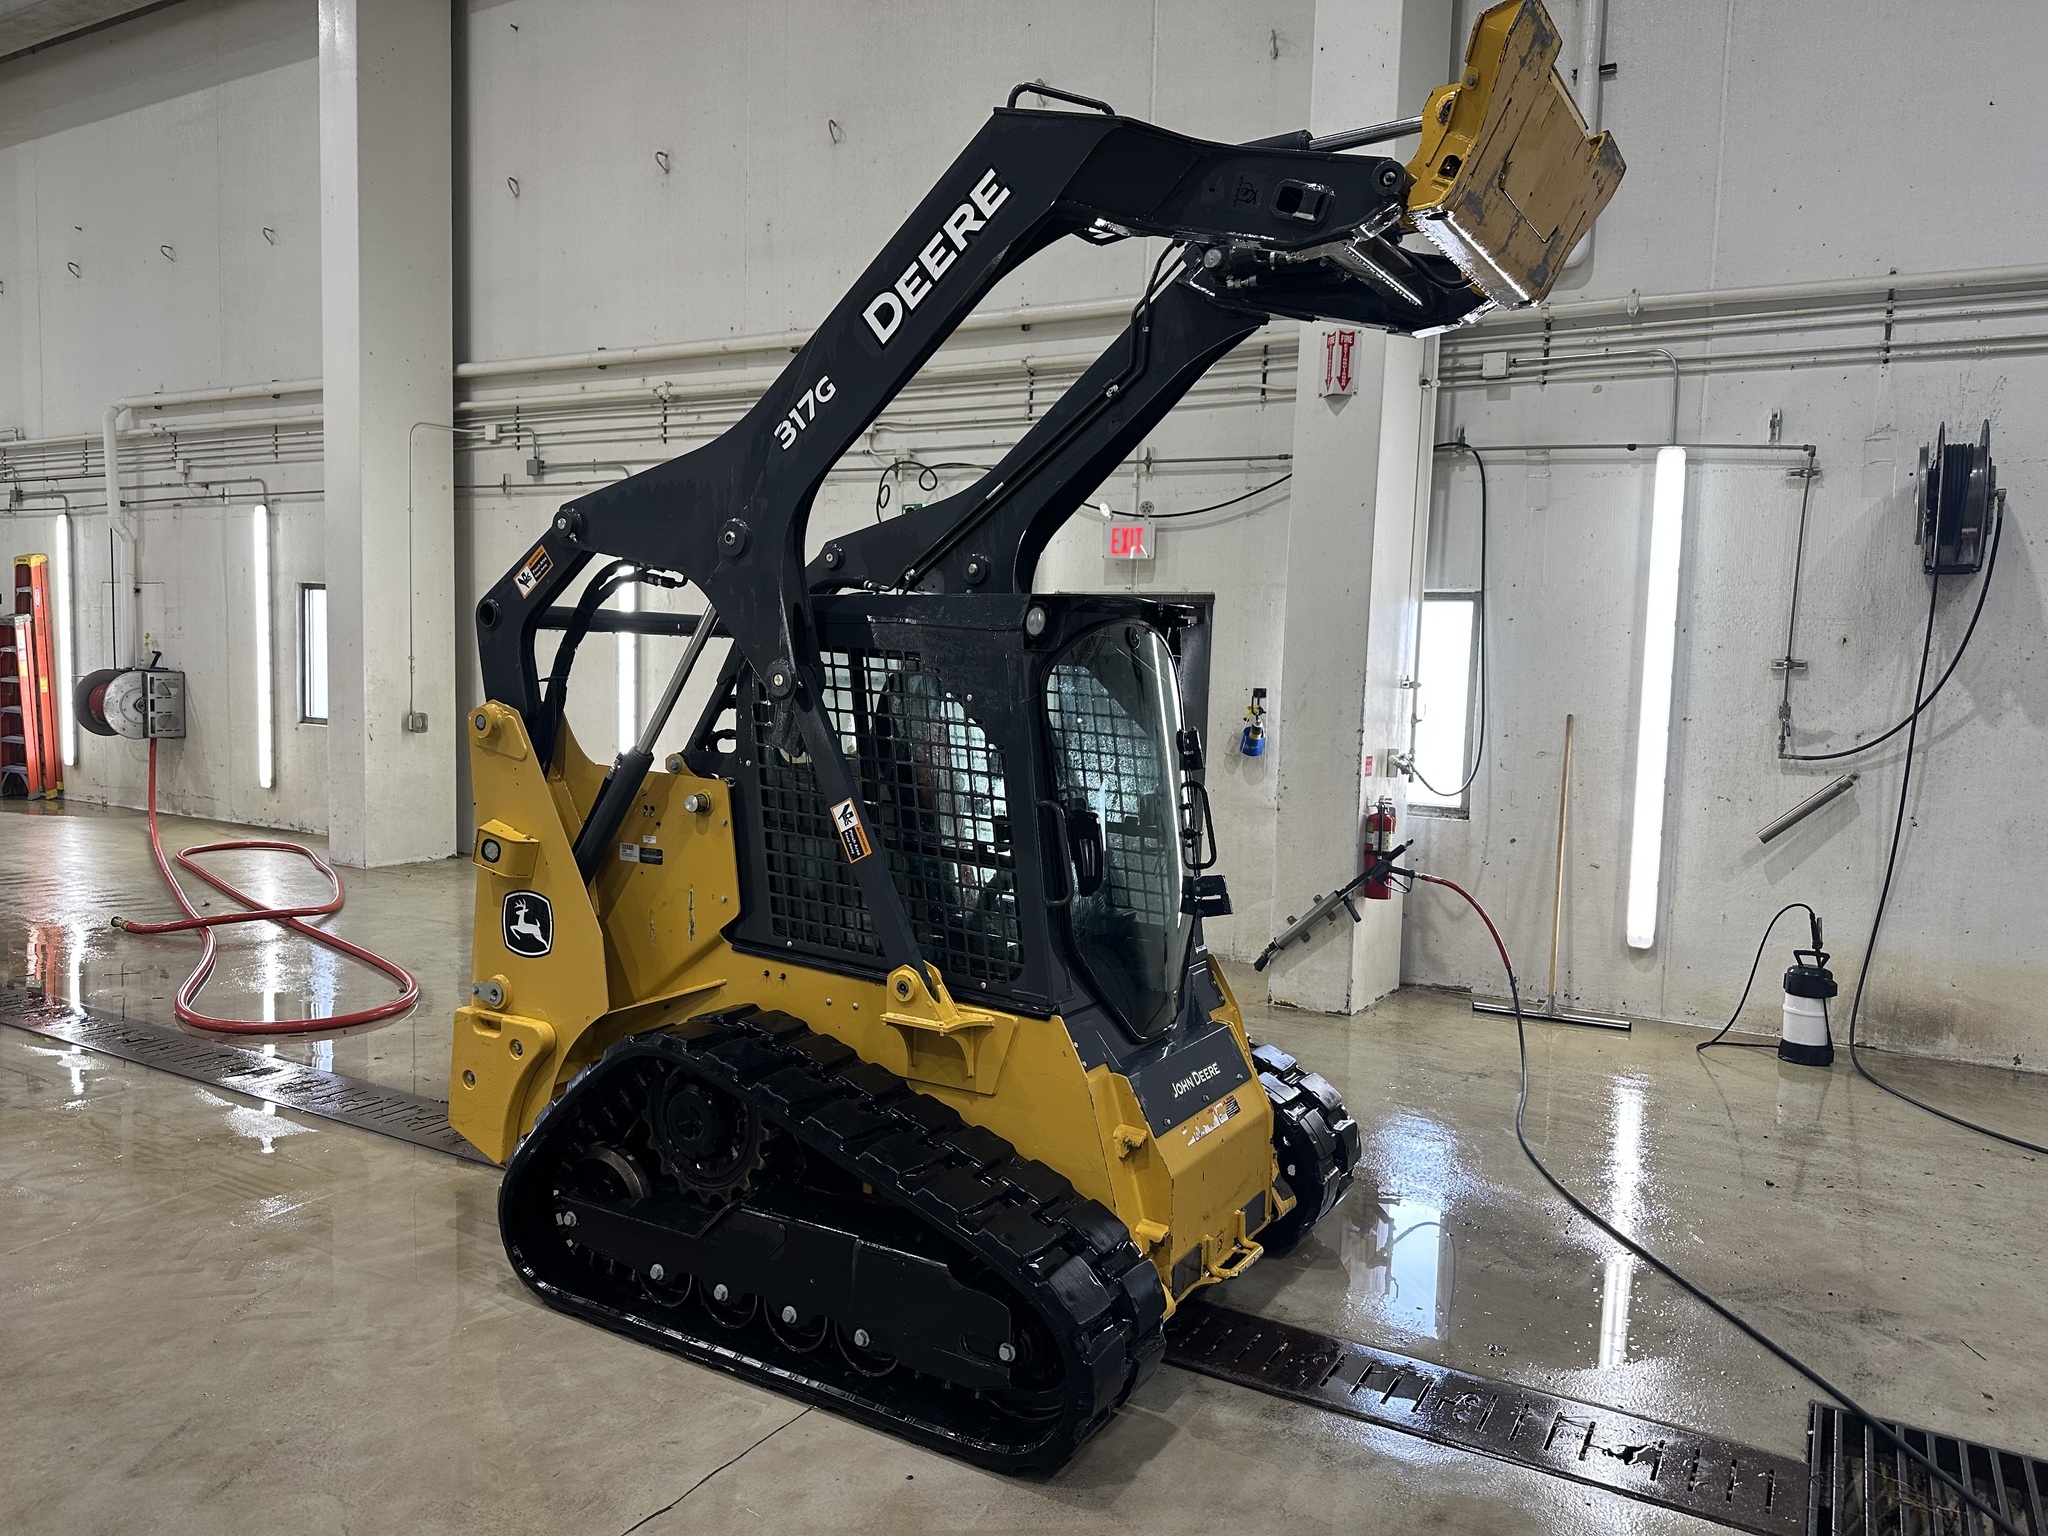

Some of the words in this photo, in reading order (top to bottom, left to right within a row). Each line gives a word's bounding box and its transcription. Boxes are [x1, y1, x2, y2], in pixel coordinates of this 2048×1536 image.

[862, 168, 1010, 344] DEERE
[1340, 334, 1353, 344] FIRE
[774, 375, 837, 450] 317G
[1111, 527, 1144, 555] EXIT
[848, 829, 857, 844] Pinch
[853, 844, 861, 856] Area
[1172, 1077, 1195, 1099] JOHN
[1191, 1062, 1220, 1086] DEERE
